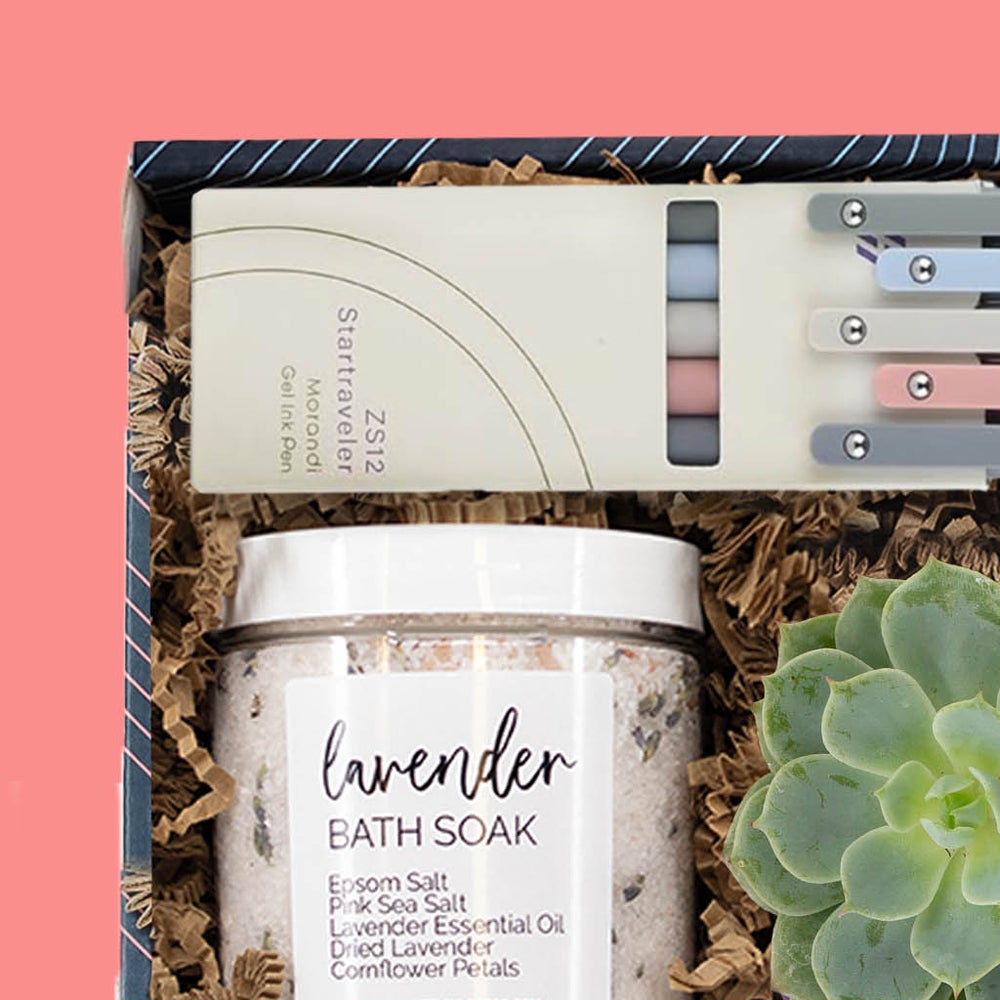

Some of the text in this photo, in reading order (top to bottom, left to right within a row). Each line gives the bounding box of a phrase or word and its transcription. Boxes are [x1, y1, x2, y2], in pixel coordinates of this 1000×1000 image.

[280, 365, 296, 398] Gel
[336, 307, 358, 474] Startraveler
[281, 404, 295, 431] Ink
[306, 378, 322, 473] Morandi
[365, 409, 386, 474] ZS12
[323, 706, 577, 801] lavender
[328, 814, 538, 850] BATH SOAK
[328, 871, 449, 898] Epsom Salt
[329, 893, 467, 915] Pink Sea Salt
[329, 913, 565, 937] Lavender Essential Oil
[330, 937, 494, 959] Dried Lavender
[330, 957, 521, 979] Cornflower Petals
